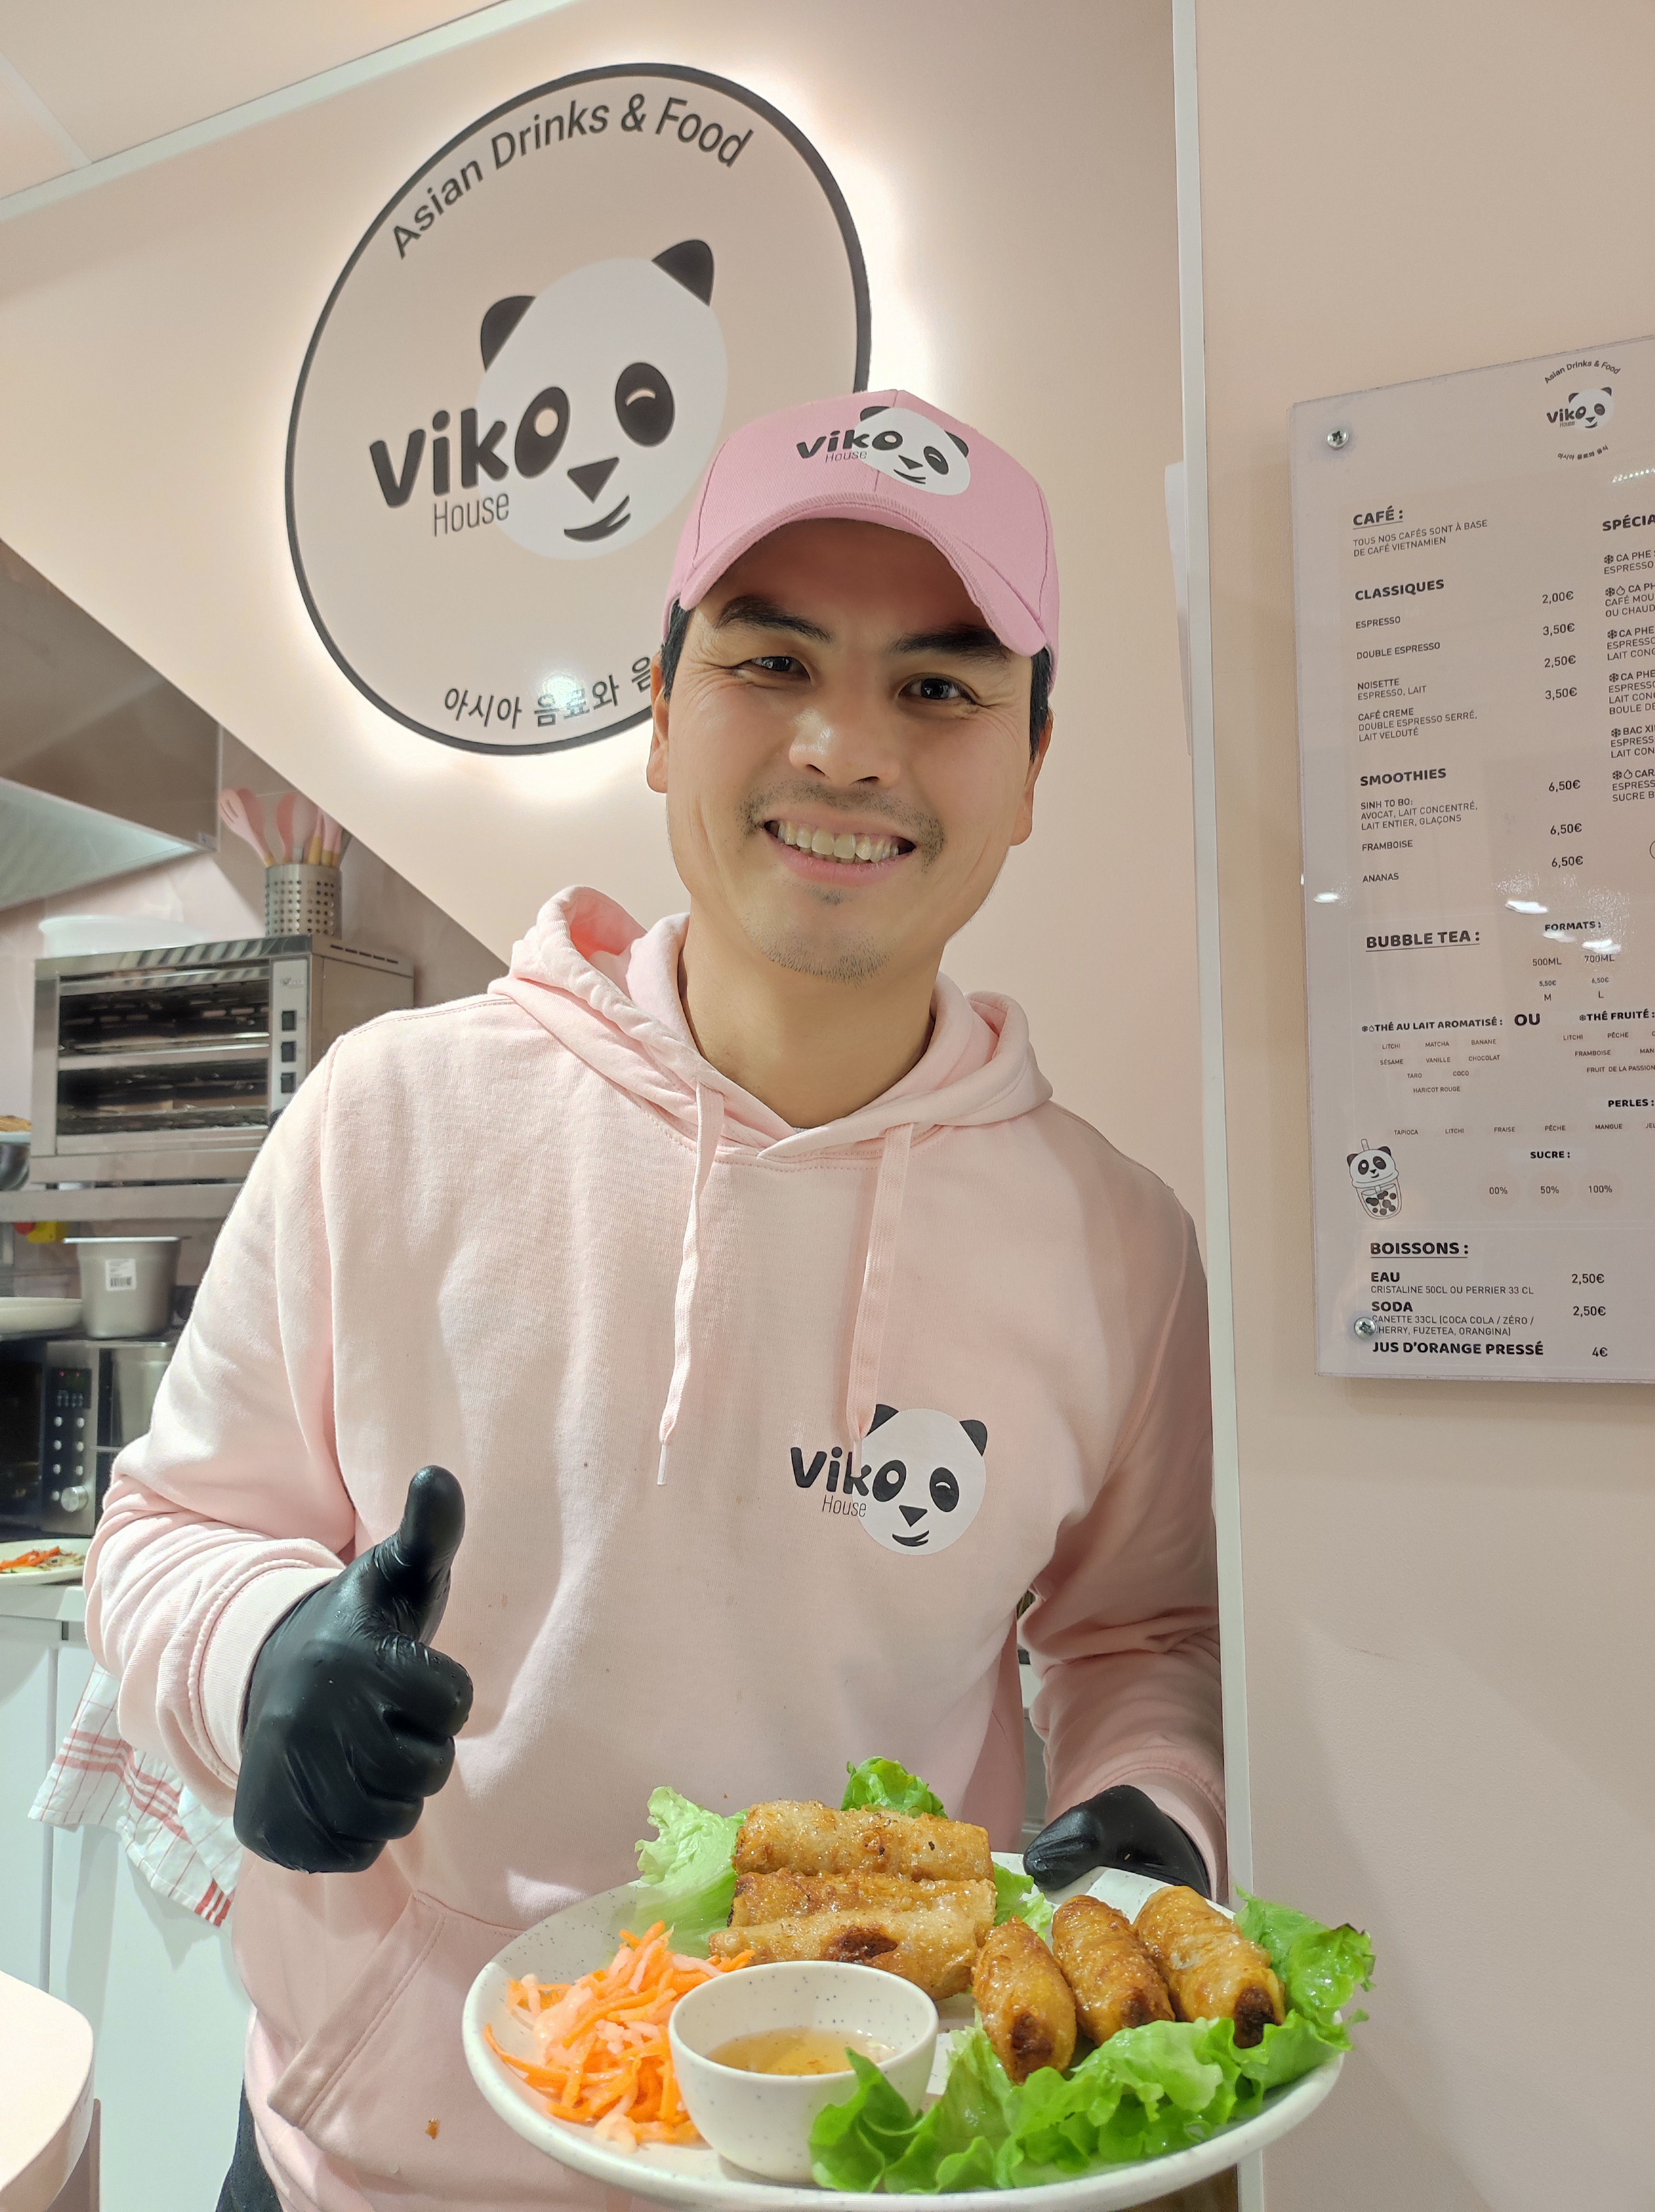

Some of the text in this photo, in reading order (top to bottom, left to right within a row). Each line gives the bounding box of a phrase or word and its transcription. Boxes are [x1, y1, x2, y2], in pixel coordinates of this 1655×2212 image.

[393, 93, 754, 259] Asian Drinks & Food
[1545, 368, 1565, 384] Asian
[1566, 360, 1592, 370] Drinks
[1601, 362, 1621, 374] Food
[434, 493, 510, 537] House
[1353, 505, 1394, 526] CAFÉ
[1353, 520, 1487, 546] TOUS NOS CAFÉS SONT À BASE
[1354, 536, 1445, 557] DE CAFÉ VIETNAMIEN
[1616, 550, 1651, 562] CA PHE
[1355, 579, 1444, 600] CLASSIQUES
[1628, 584, 1641, 593] CA
[1543, 591, 1573, 604] 2,00€
[1605, 595, 1629, 606] CAFÉ
[1606, 604, 1655, 617] OU CHAUD
[1356, 616, 1400, 629] ESPRESSO
[1543, 623, 1574, 636] 3,50€
[1619, 626, 1654, 637] CA PHE
[1357, 642, 1440, 659] DOUBLE ESPRESSO
[1607, 651, 1627, 660] LAIT
[1544, 655, 1576, 668] 2,50€
[1621, 670, 1655, 680] CA PHE
[1358, 678, 1399, 690] NOISETTE
[1358, 686, 1426, 700] ESPRESSO, LAIT
[1545, 687, 1577, 700] 3,50€
[1609, 695, 1629, 704] LAIT
[444, 688, 522, 729] 아시아
[1359, 708, 1413, 721] CAFÉ CREME
[1610, 704, 1641, 715] BOULE
[1359, 709, 1477, 731] DOUBLE ESPRESSO SERRÉ,
[1359, 727, 1418, 742] LAIT VELOUTÉ
[1623, 726, 1642, 735] BAC
[1611, 749, 1631, 758] LAIT
[1360, 768, 1446, 786] SMOOTHIES
[1549, 780, 1580, 792] 6,50€
[1361, 801, 1381, 809] SINH
[1398, 798, 1412, 806] BO:
[1613, 792, 1645, 802] SUCRE
[1361, 800, 1477, 820] AVOCAT, LAIT CONCENTRÉ,
[1362, 814, 1461, 830] LAIT ENTIER, GLAÇONS
[1551, 823, 1582, 836] 6,50€
[1362, 840, 1413, 851] FRAMBOISE
[1552, 856, 1583, 868] 6,50€
[1363, 873, 1399, 883] ANANAS
[1545, 921, 1595, 931] FORMATS
[1367, 931, 1471, 948] BUBBLE TEA
[1533, 954, 1614, 966] 500ML 700ML
[1514, 1013, 1540, 1026] OU
[1586, 1008, 1649, 1021] THÉ FRUITÉ
[1374, 1022, 1394, 1032] THÉ
[1438, 1016, 1497, 1028] AROMATISÉ
[1608, 1099, 1648, 1107] PERLES
[1370, 1242, 1459, 1254] BOISSONS
[1371, 1272, 1400, 1282] EAU
[1572, 1274, 1604, 1285] 2,50€
[1372, 1301, 1413, 1312] SODA
[1573, 1306, 1606, 1317] 2,50€
[1372, 1315, 1412, 1323] CANETTE
[1470, 1316, 1494, 1324] COLA
[1503, 1315, 1527, 1324] ZÉRO
[1376, 1326, 1410, 1335] HERRY,
[1413, 1327, 1456, 1336] FUZETEA,
[1373, 1341, 1543, 1355] JUS D'ORANGE PRESSÉ
[1592, 1347, 1607, 1357] 4€
[822, 1495, 867, 1518] House
